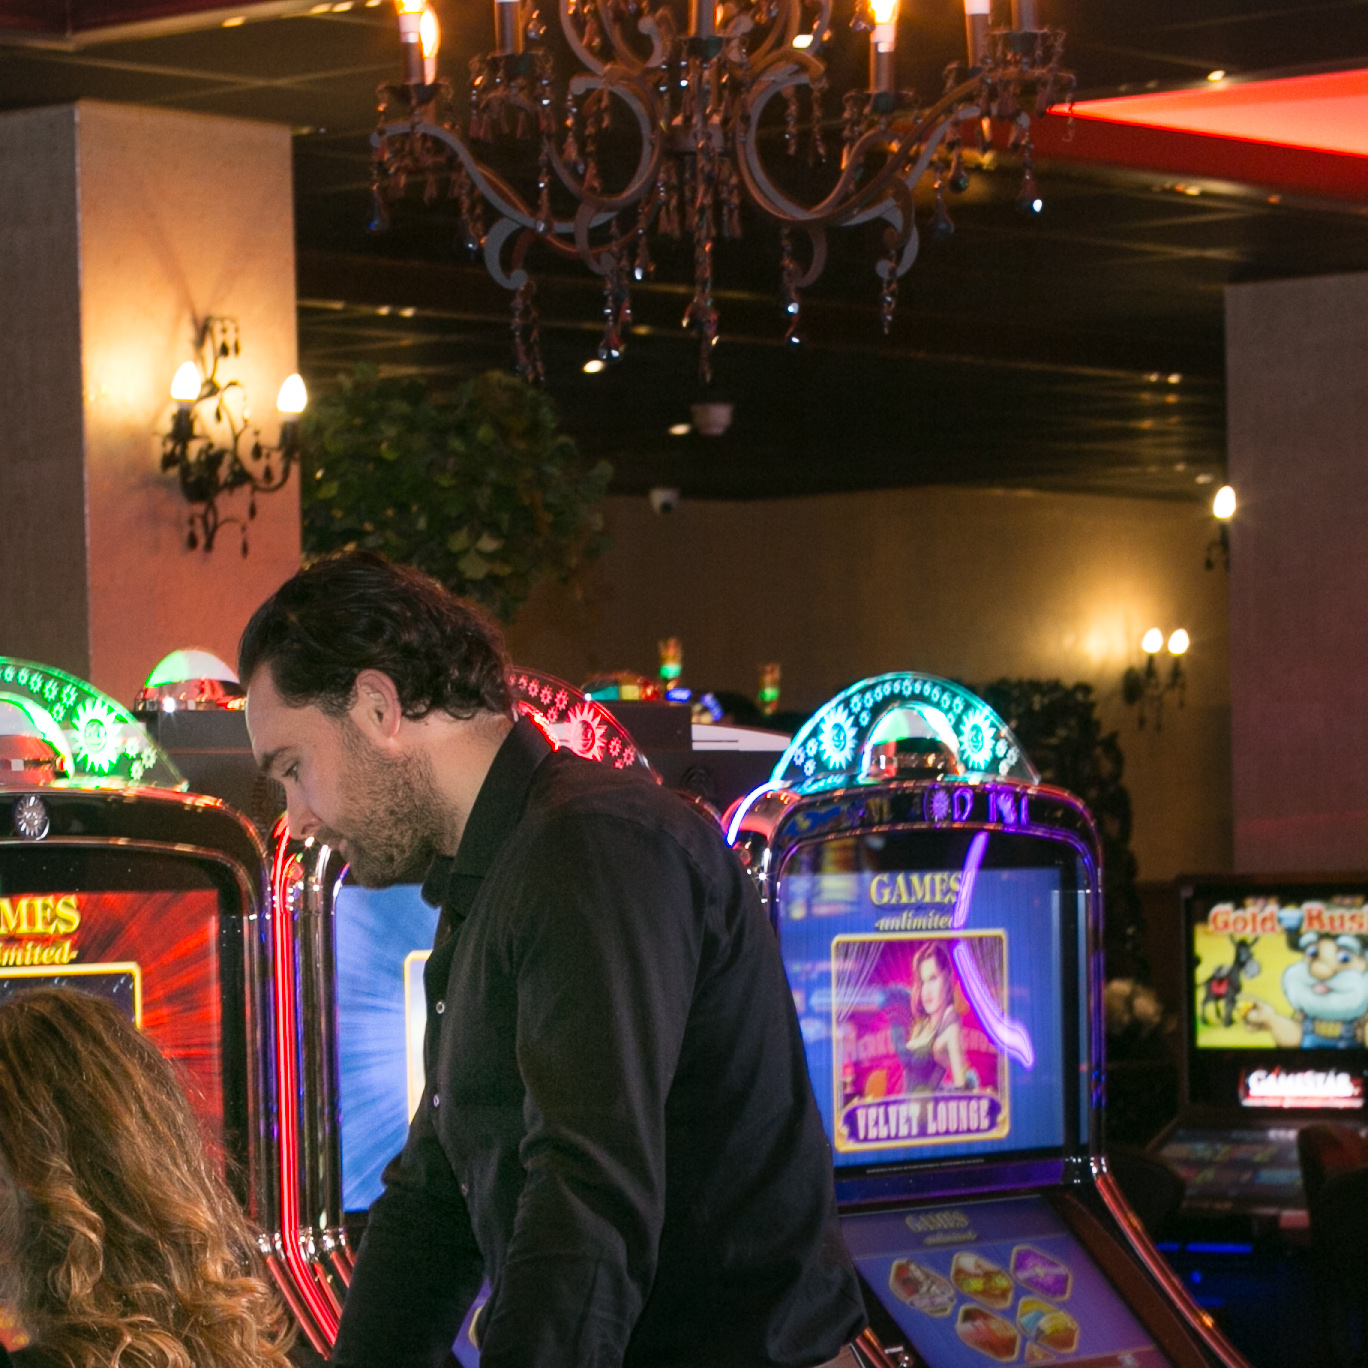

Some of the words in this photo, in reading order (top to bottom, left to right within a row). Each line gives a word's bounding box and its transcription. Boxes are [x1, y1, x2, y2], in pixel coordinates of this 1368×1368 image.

[870, 872, 963, 907] GAMES
[1209, 903, 1279, 934] Gold
[856, 1103, 922, 1140] VELVET
[925, 1098, 990, 1135] LOUNGE
